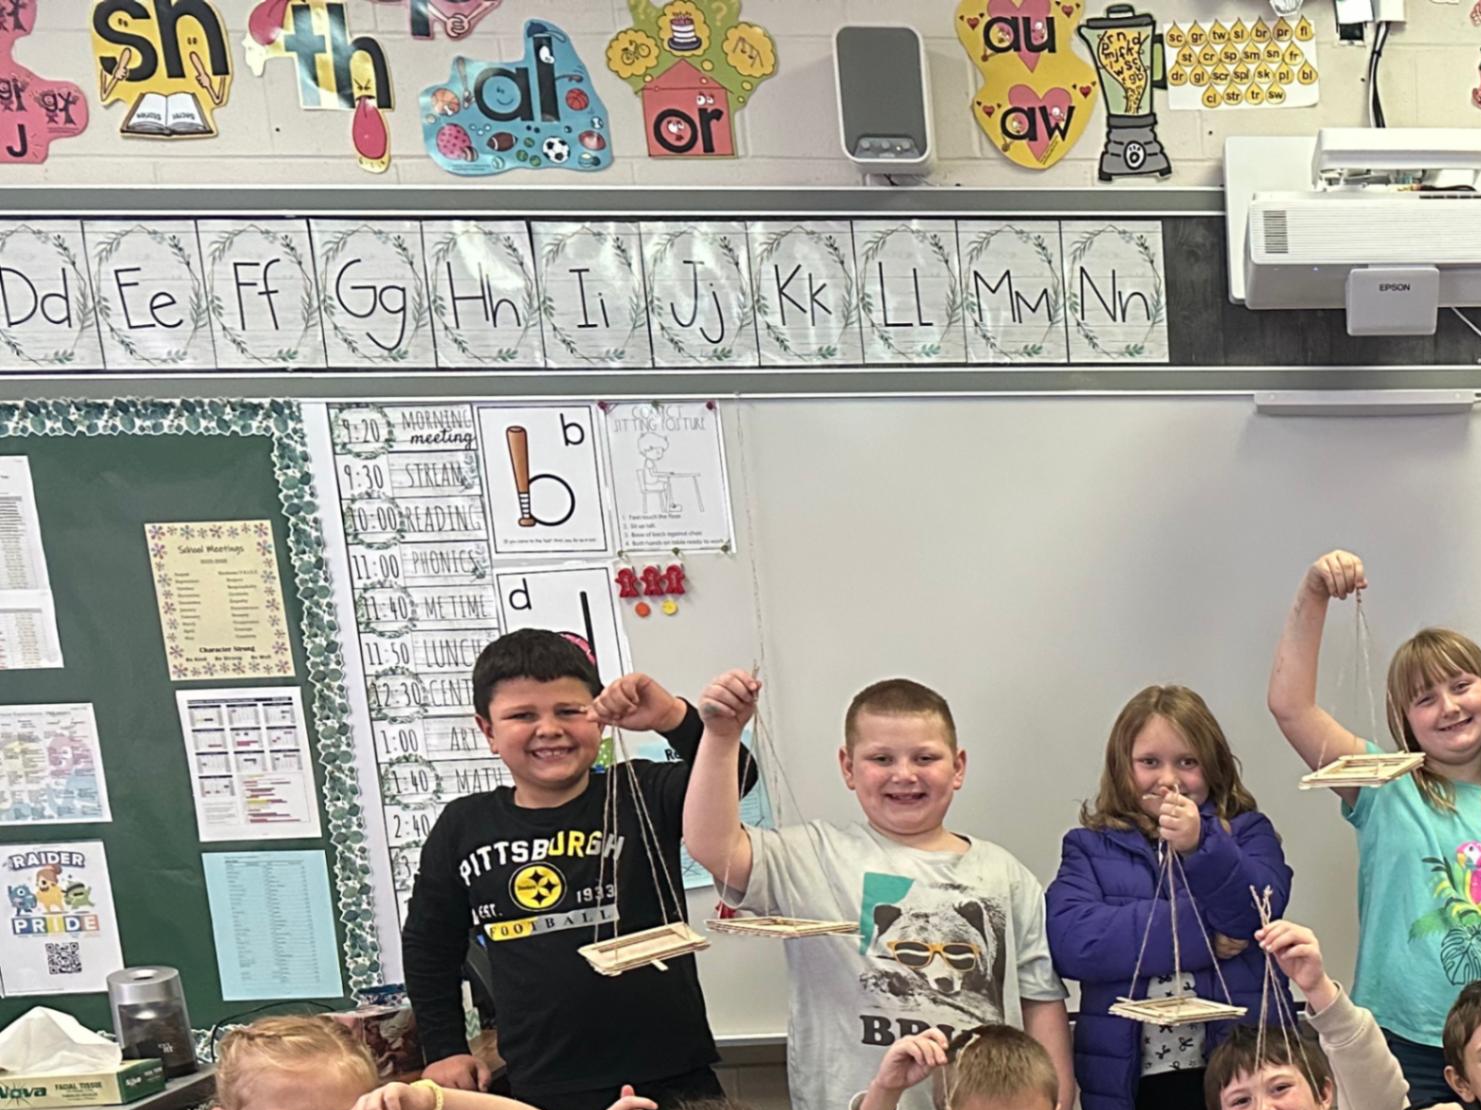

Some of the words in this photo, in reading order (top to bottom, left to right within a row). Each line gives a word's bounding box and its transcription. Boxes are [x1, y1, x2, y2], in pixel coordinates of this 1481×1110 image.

[983, 12, 1055, 55] au
[475, 36, 561, 123] al
[653, 107, 724, 154] or
[1000, 103, 1076, 144] aw
[1, 267, 72, 328] Dd
[113, 267, 184, 329] Ee
[233, 258, 281, 330] Ff
[452, 262, 521, 329] Hh
[568, 267, 610, 329] Ii
[670, 260, 726, 344] Jj
[776, 263, 832, 328] Kk
[973, 268, 1056, 324] Mm
[1081, 265, 1151, 324] Nn
[1378, 283, 1411, 293] EPSON
[334, 258, 406, 352] Gg
[401, 410, 472, 430] MORNING
[560, 413, 585, 446] b
[410, 430, 476, 450] meeting
[344, 464, 384, 490] 9:30
[405, 462, 464, 488] STREAM
[405, 505, 482, 532] READING
[352, 555, 399, 580] 11:00
[412, 549, 476, 574] PHONICS
[509, 577, 532, 610] d
[365, 642, 410, 666] 11:50
[380, 729, 418, 754] 1:00
[451, 726, 479, 751] ART
[393, 769, 429, 794] 1:40
[455, 766, 503, 794] MATH
[394, 814, 430, 838] 2:40
[10, 852, 85, 870] RAIDER
[459, 831, 625, 887] PITTSBURGH
[577, 884, 615, 903] 1933
[12, 915, 99, 934] PRIDE
[490, 909, 611, 940] FOOTBALL
